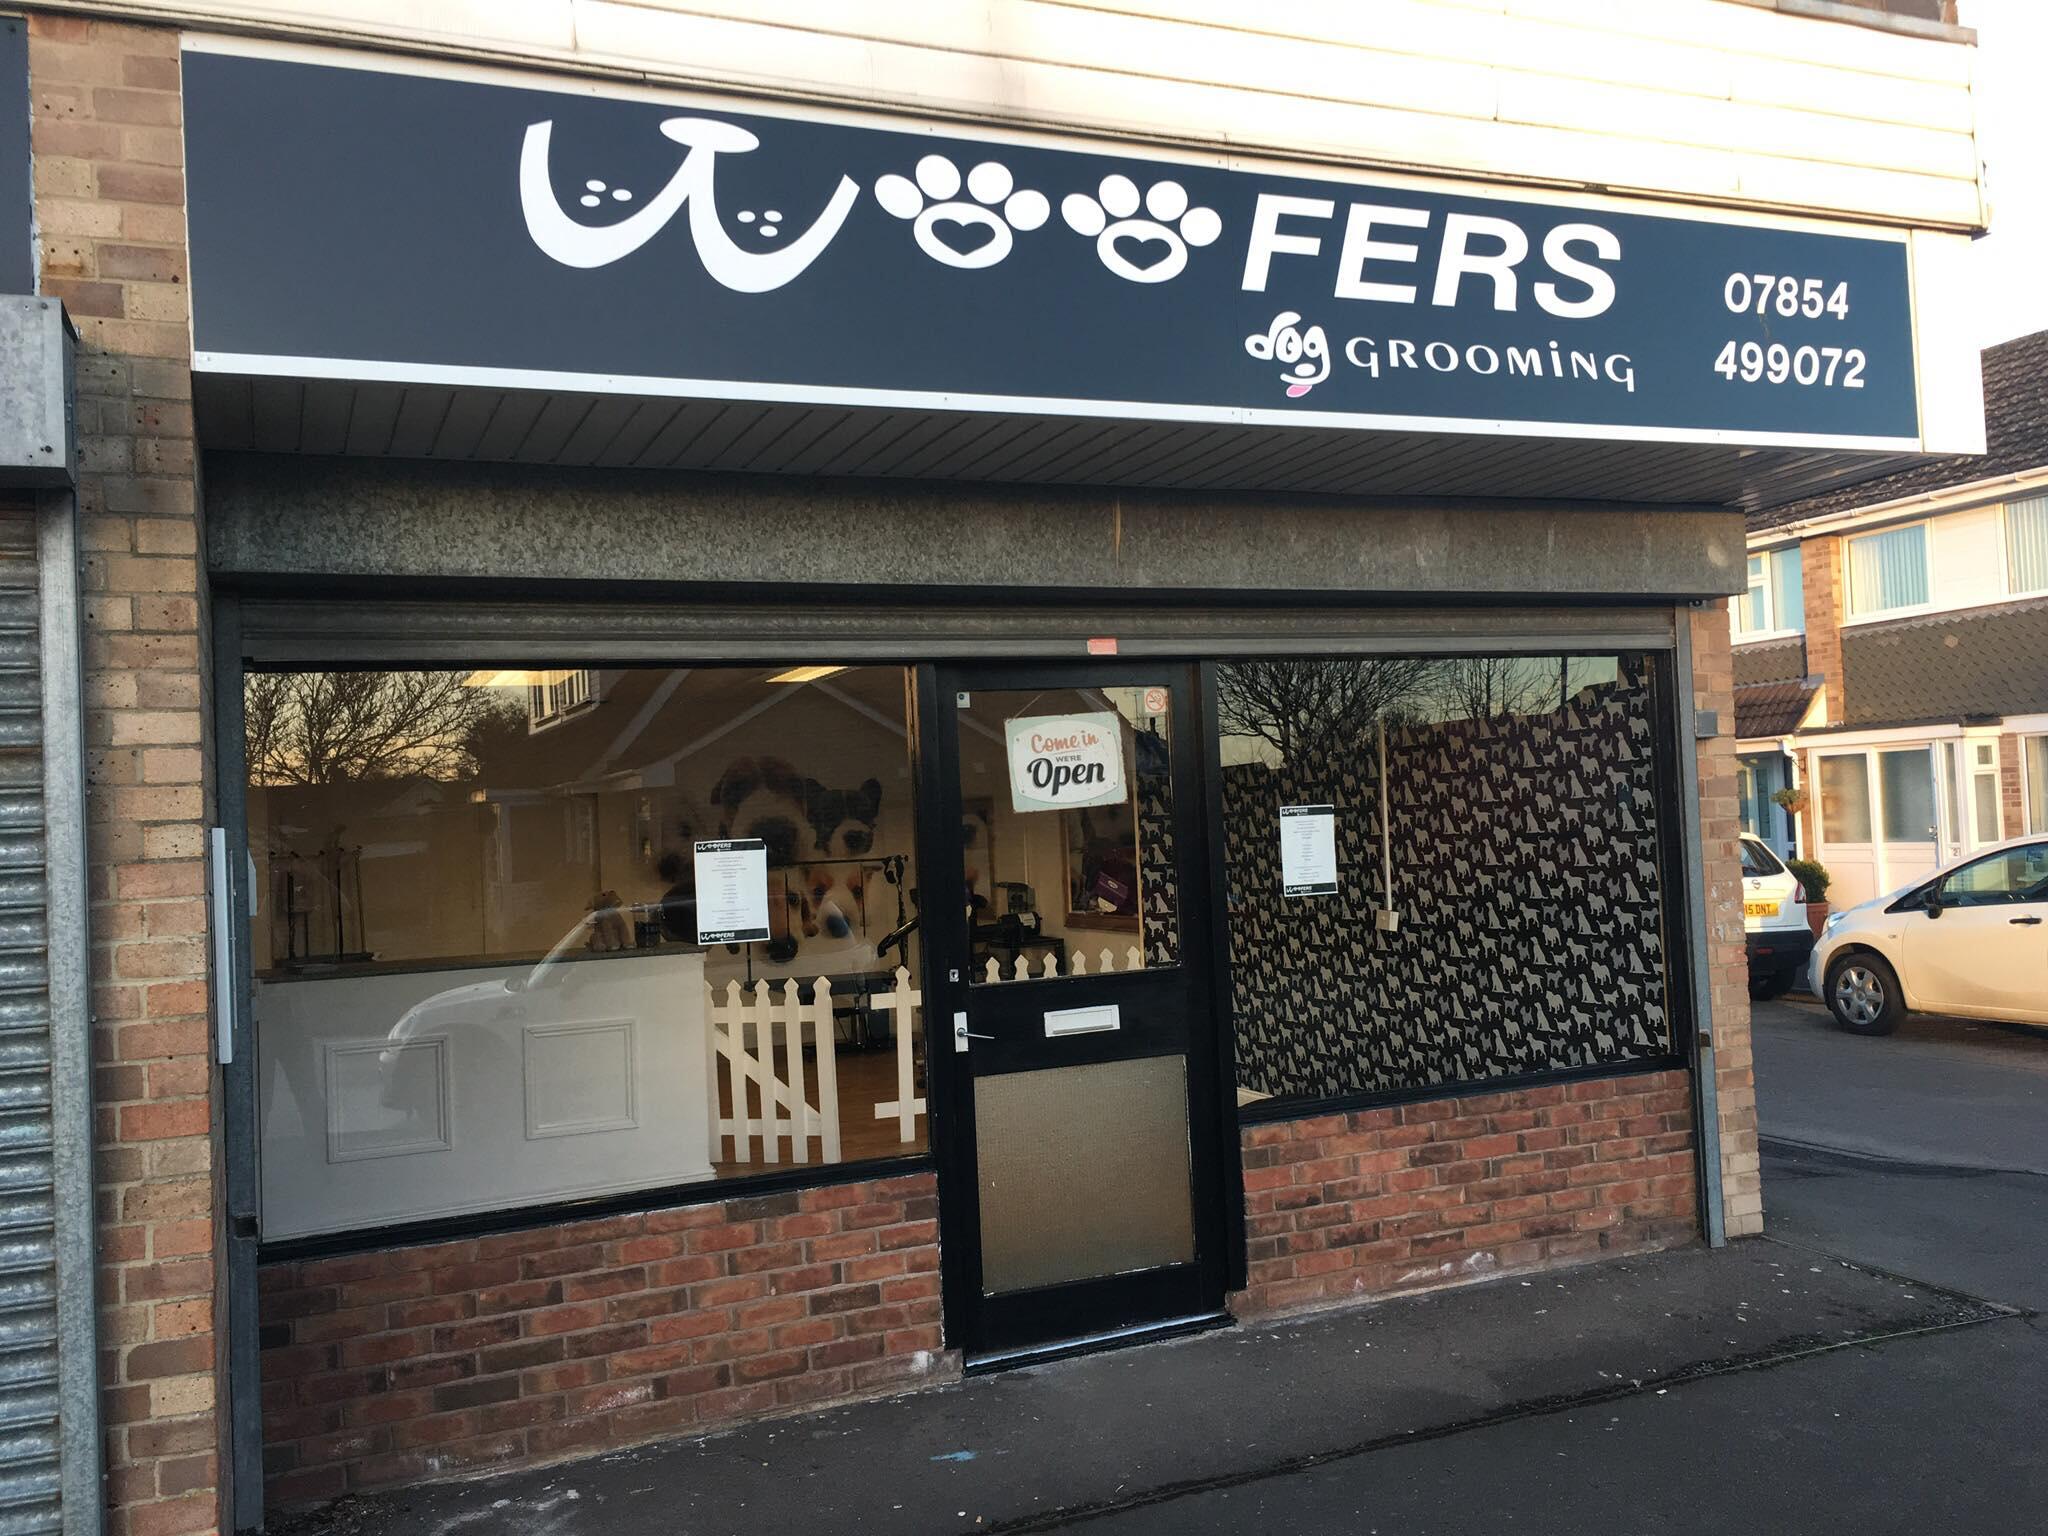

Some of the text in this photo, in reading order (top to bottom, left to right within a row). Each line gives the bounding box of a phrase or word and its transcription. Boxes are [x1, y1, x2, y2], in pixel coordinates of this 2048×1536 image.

[1725, 272, 1849, 321] 07854
[1244, 310, 1331, 386] dog
[1714, 340, 1866, 389] 499072
[1031, 730, 1099, 753] Come in
[1026, 757, 1106, 796] Open
